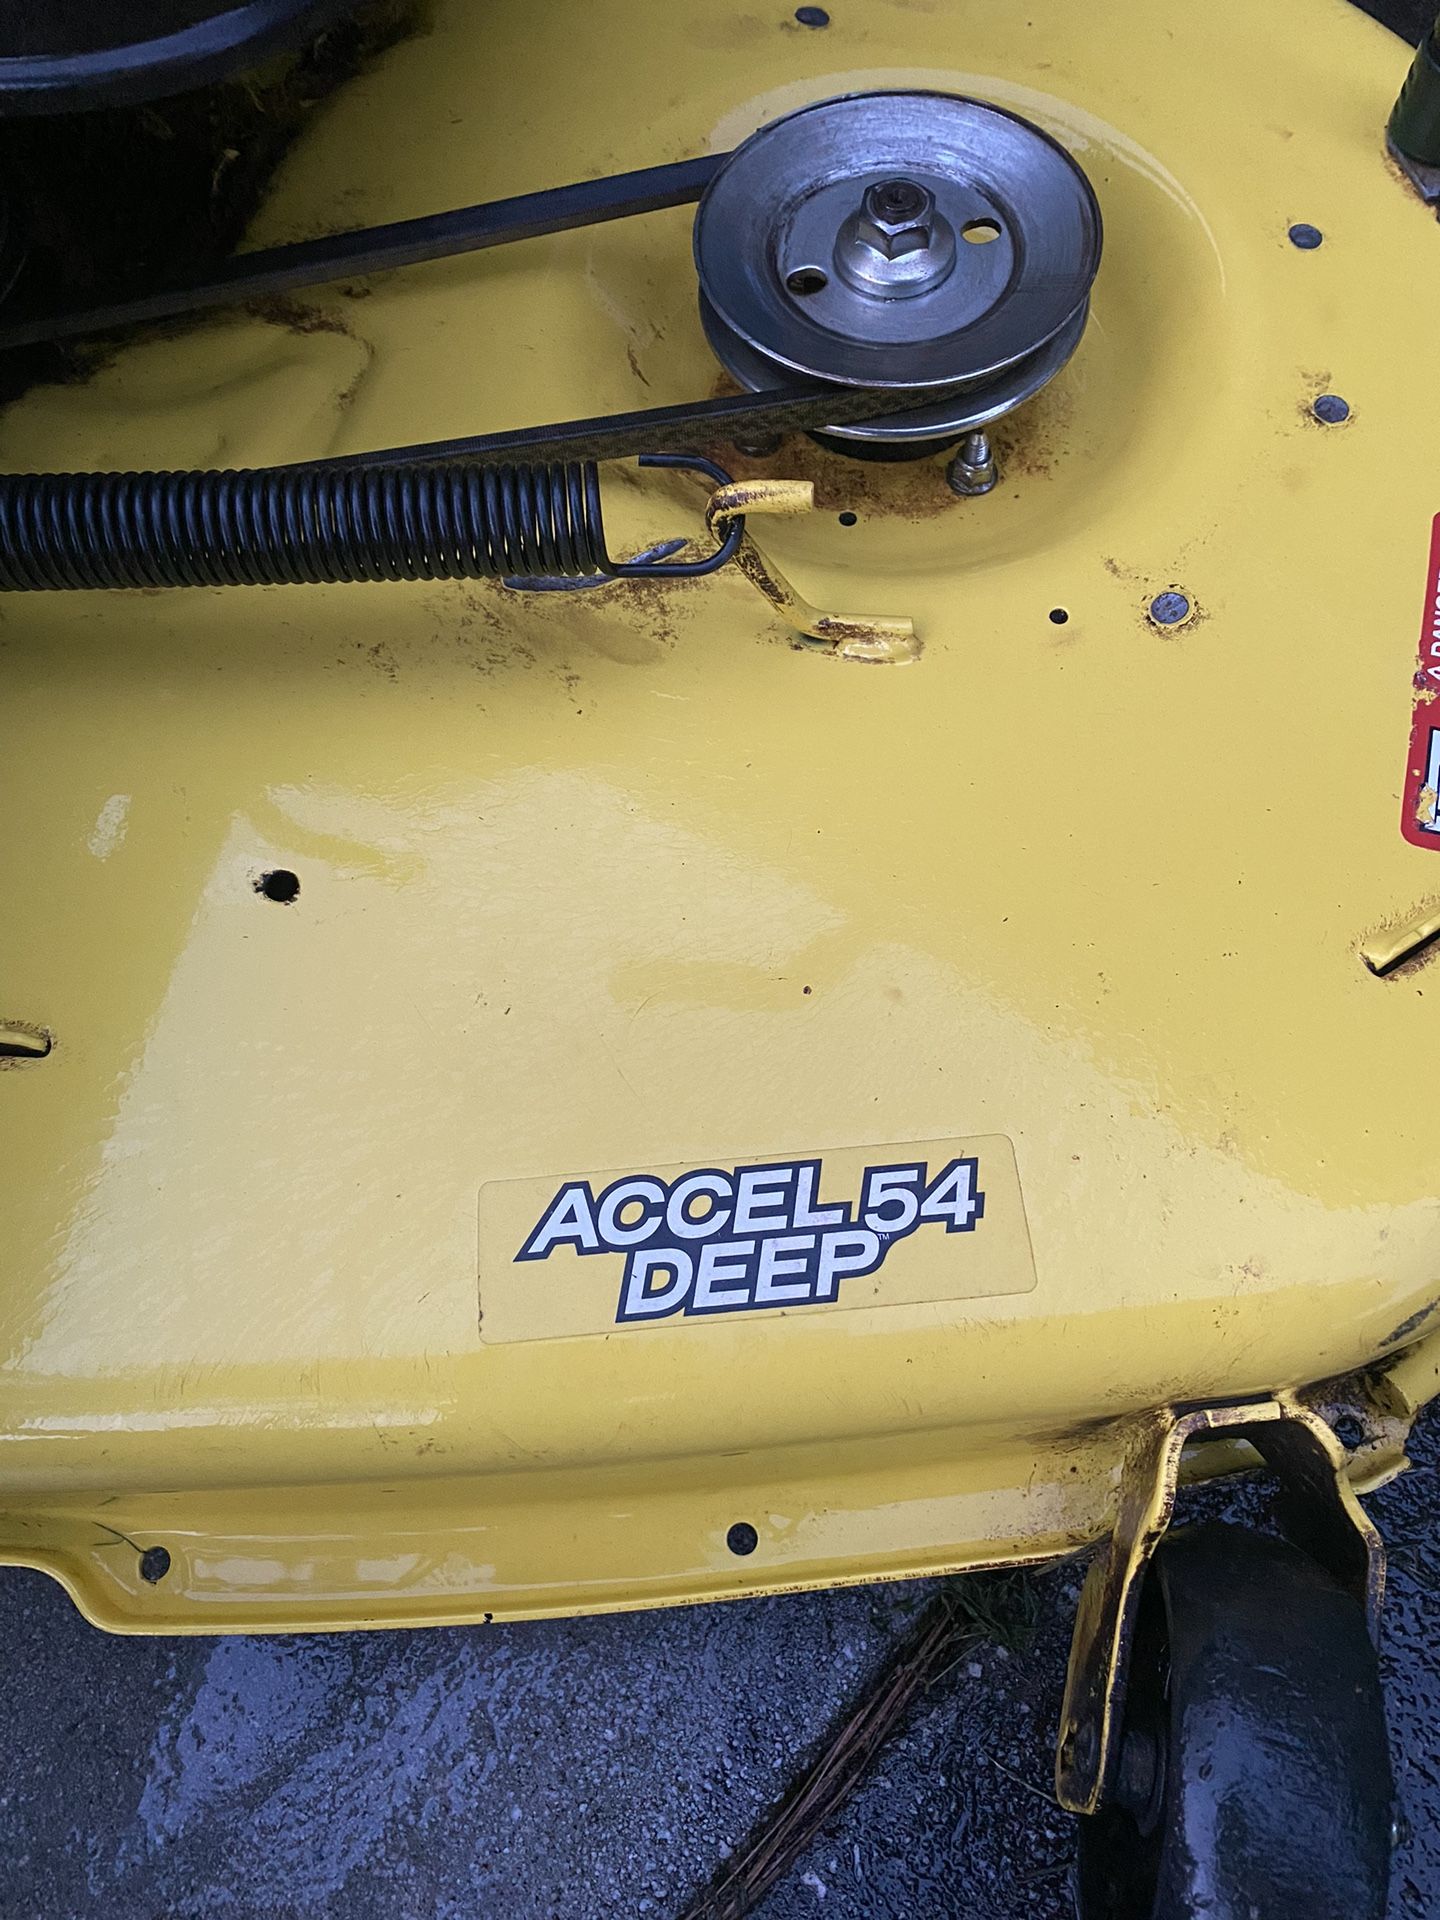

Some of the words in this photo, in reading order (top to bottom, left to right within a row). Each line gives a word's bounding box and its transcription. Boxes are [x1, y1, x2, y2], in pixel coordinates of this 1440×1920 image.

[525, 1164, 845, 1255] ACCEL
[863, 1163, 977, 1234] 54
[622, 1229, 880, 1317] DEEP
